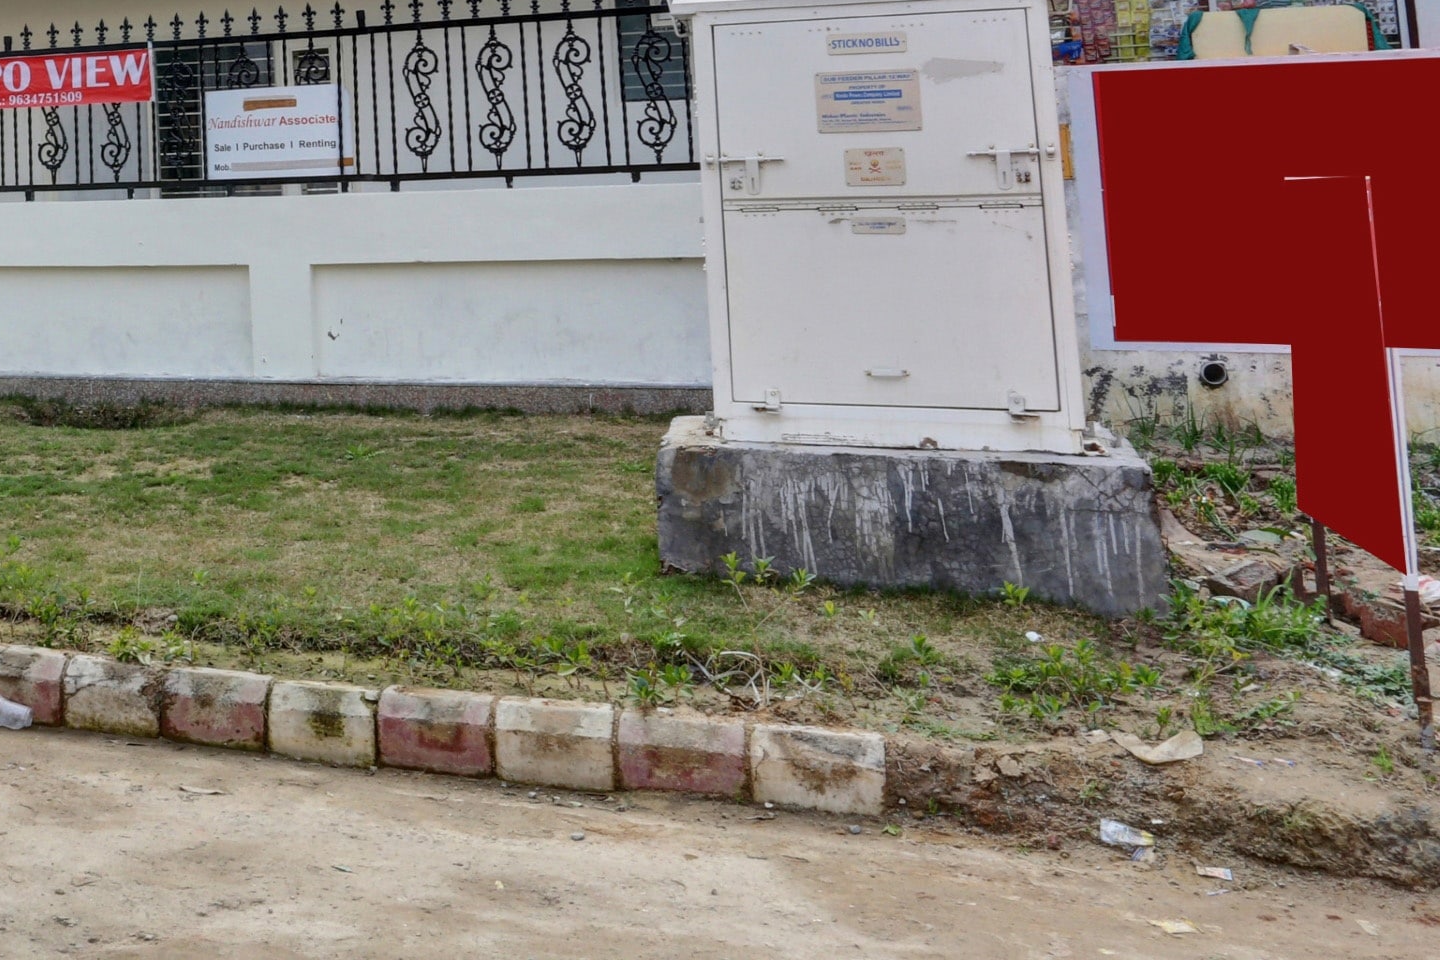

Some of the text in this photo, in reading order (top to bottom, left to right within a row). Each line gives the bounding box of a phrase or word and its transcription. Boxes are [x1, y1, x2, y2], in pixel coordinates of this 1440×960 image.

[831, 37, 900, 49] STICK NO BILLS
[44, 52, 148, 90] VIEW
[8, 91, 82, 105] 9634751809
[208, 113, 340, 130] Nandishwar Associate
[214, 143, 232, 152] Sale
[243, 141, 285, 151] Purchase
[299, 139, 337, 149] Renting
